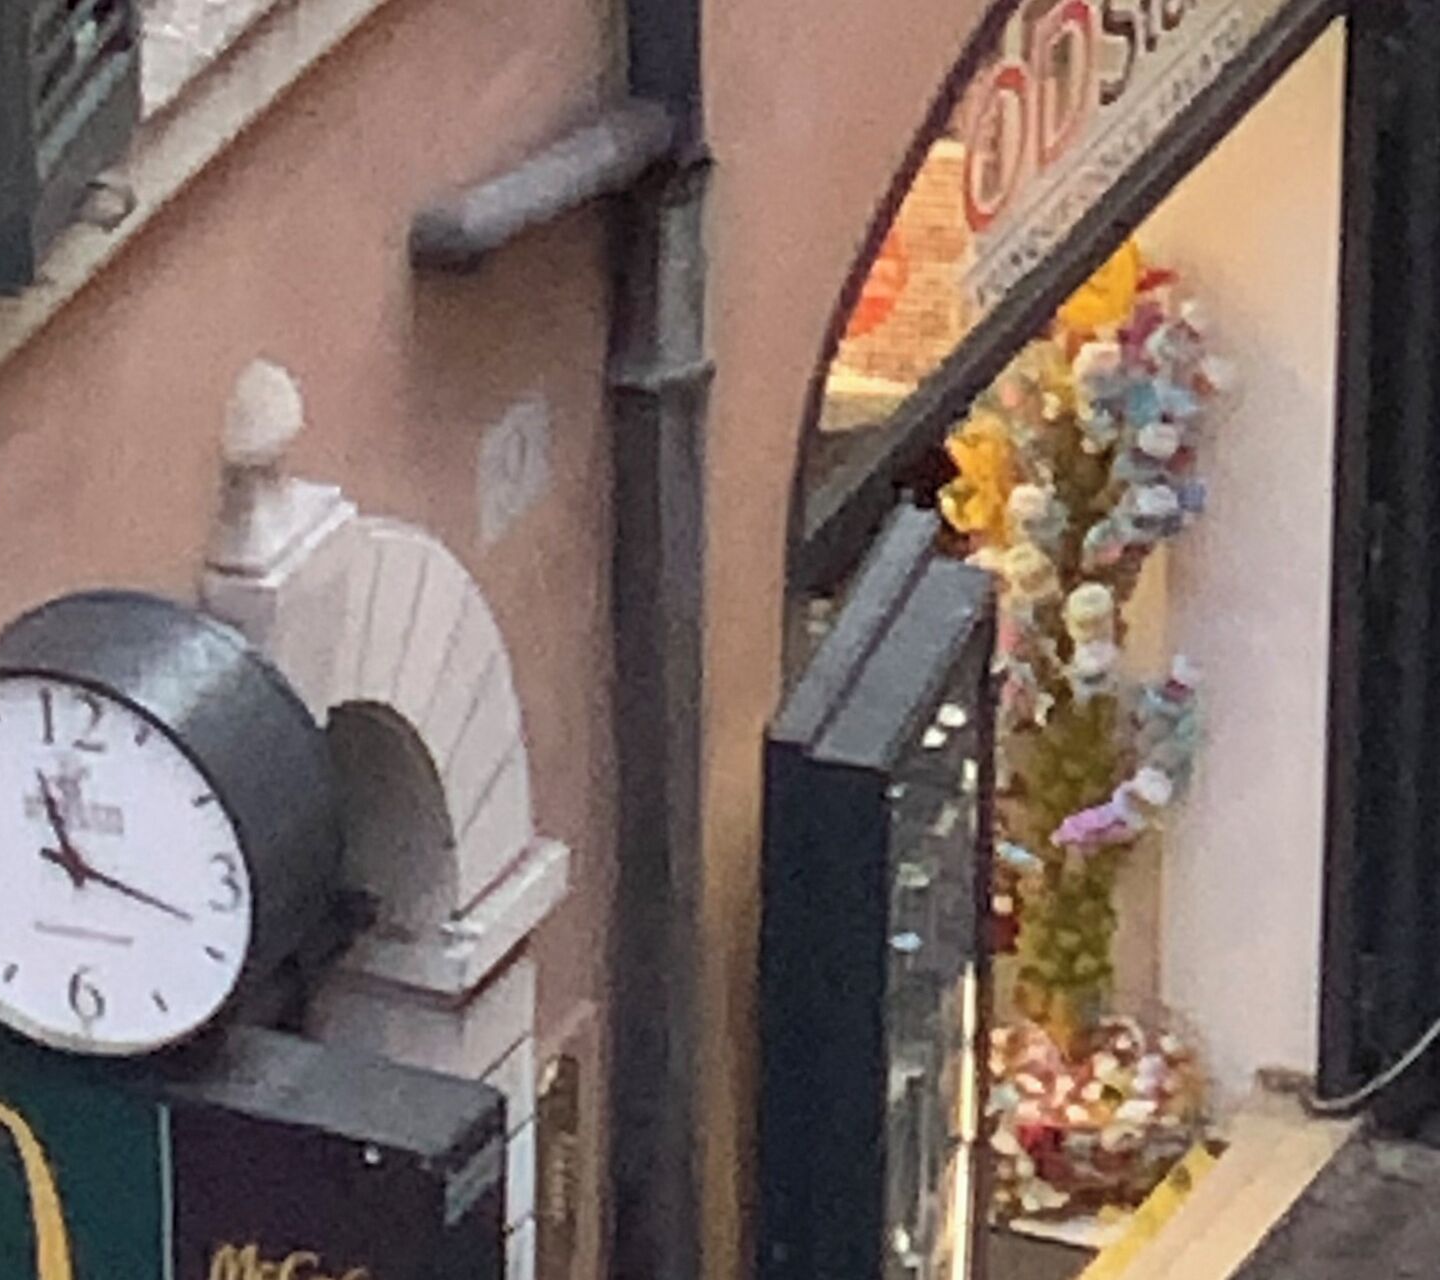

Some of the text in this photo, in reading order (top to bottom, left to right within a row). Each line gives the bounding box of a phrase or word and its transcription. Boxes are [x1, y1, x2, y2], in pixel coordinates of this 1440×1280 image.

[40, 686, 107, 753] 12
[208, 852, 244, 913] 3
[68, 966, 107, 1022] 6
